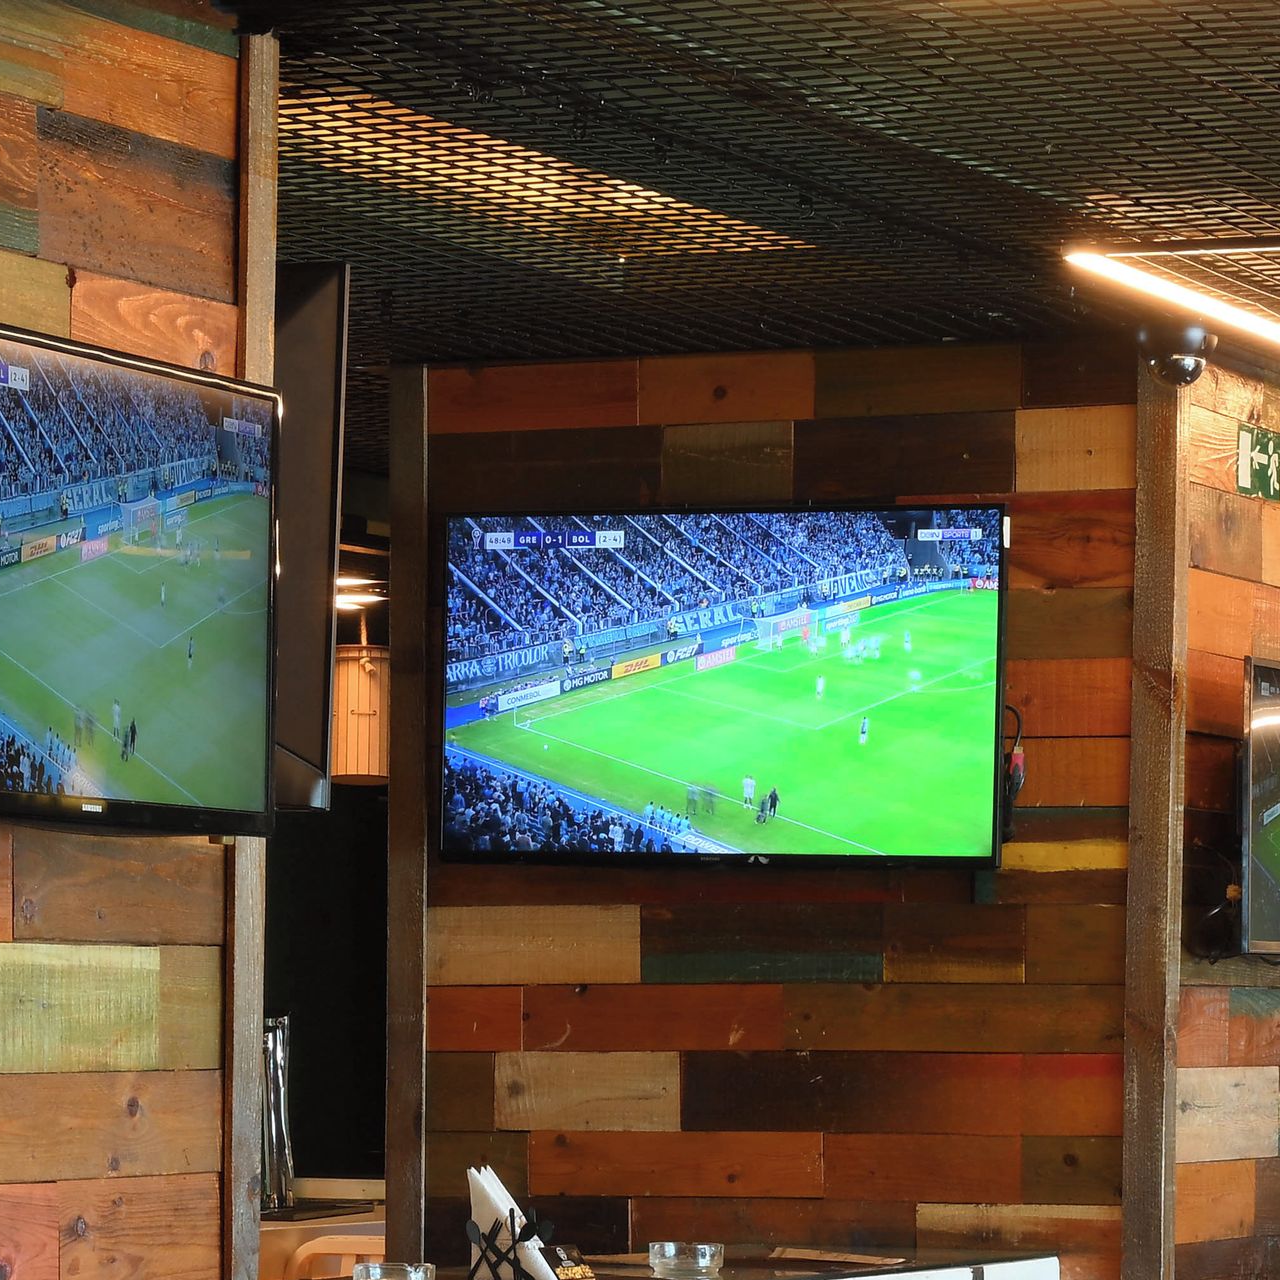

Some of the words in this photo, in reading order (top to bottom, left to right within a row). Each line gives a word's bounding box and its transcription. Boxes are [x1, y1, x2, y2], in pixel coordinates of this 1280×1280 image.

[520, 536, 537, 544] GRE
[545, 536, 562, 544] 0-1
[572, 535, 590, 543] BOL
[943, 531, 969, 539] SPORTS
[497, 644, 549, 672] TRICOLOR
[572, 677, 584, 688] MG
[585, 670, 608, 684] MOTOR
